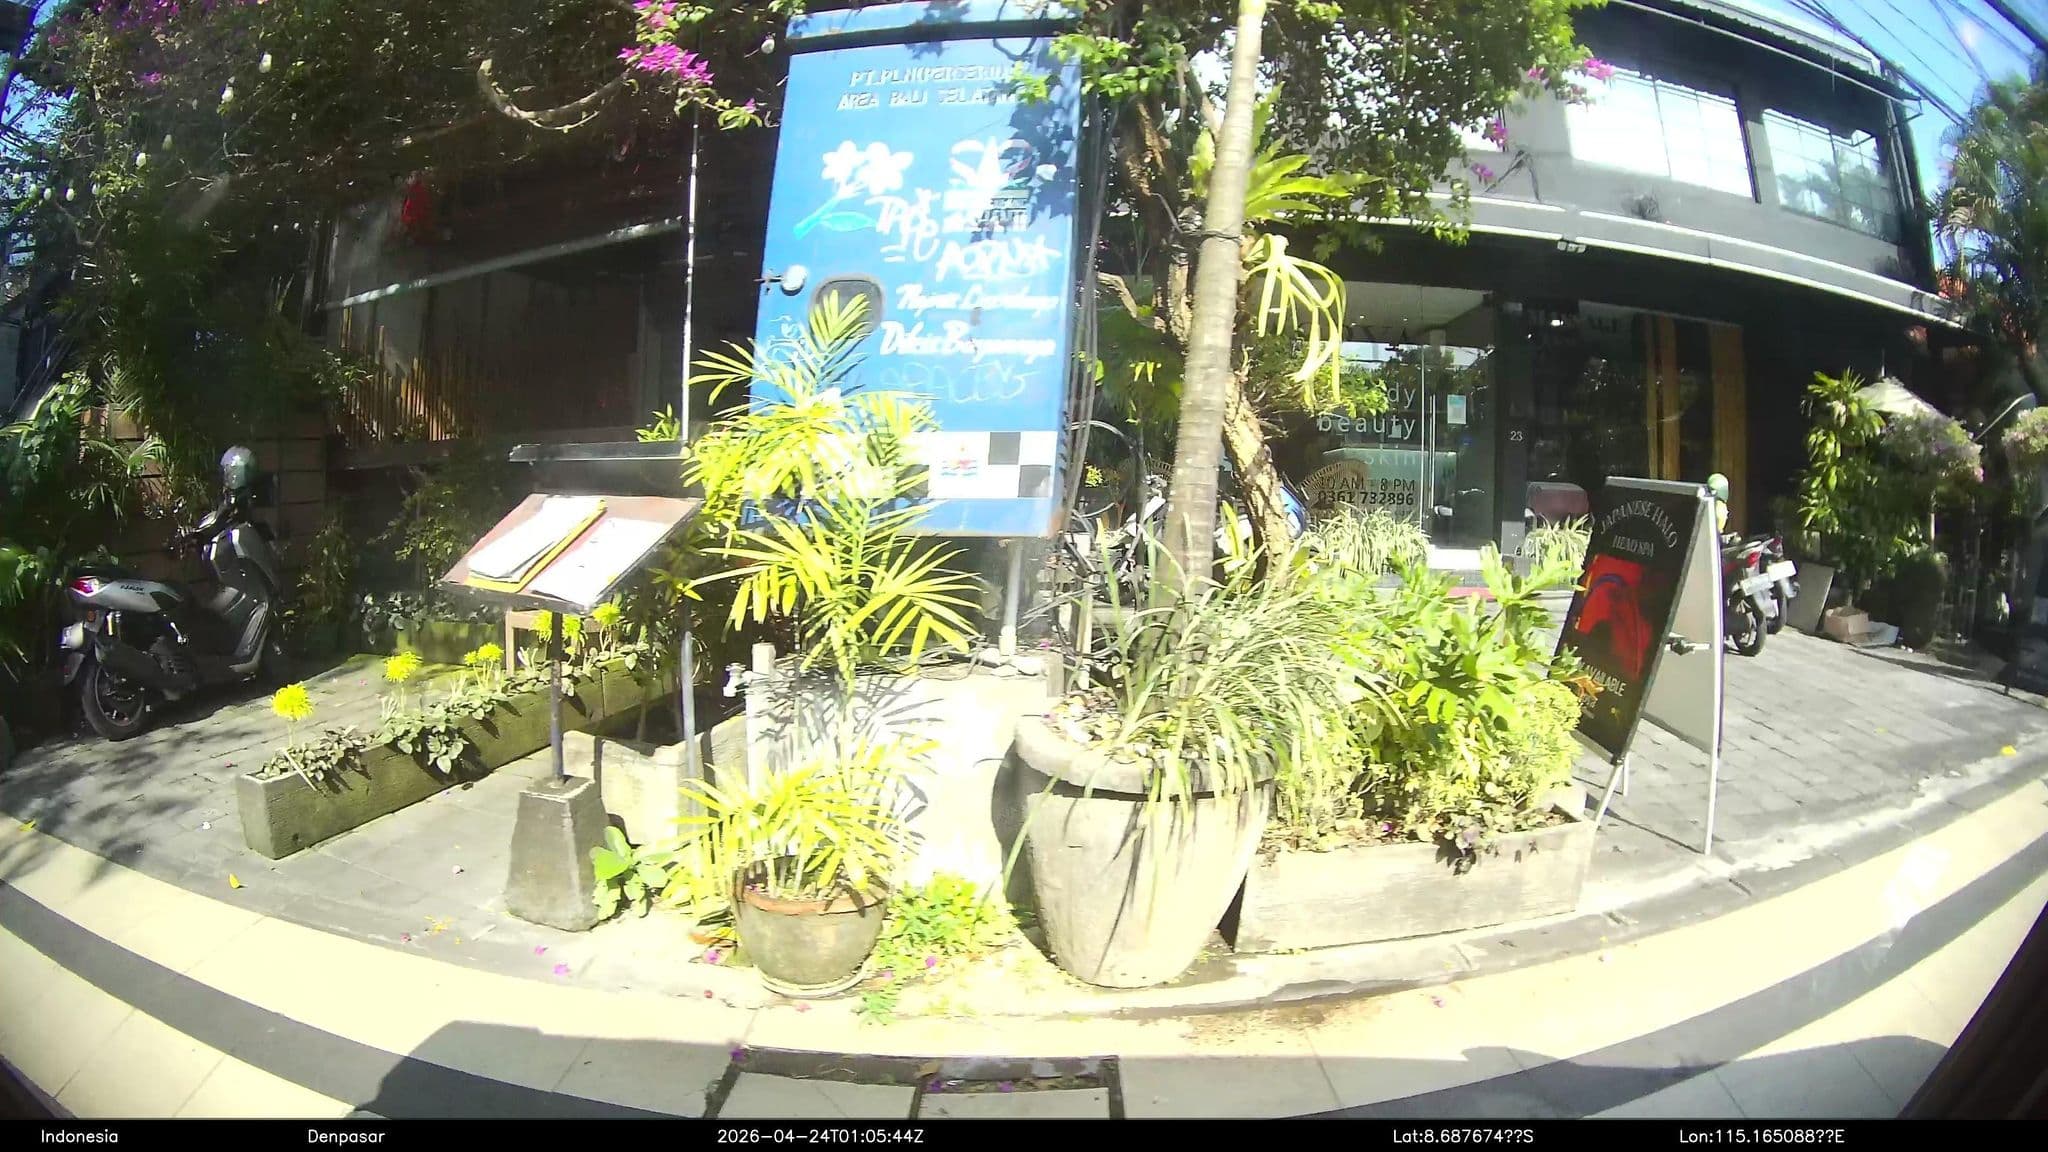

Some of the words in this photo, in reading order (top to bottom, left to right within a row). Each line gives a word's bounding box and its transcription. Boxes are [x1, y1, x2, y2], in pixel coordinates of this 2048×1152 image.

[888, 90, 929, 106] BALI
[1387, 382, 1417, 409] dy
[1317, 412, 1416, 440] beauty
[1510, 430, 1523, 442] 23
[1340, 476, 1364, 492] AM
[1379, 478, 1389, 492] 8
[1393, 478, 1415, 494] PM
[1318, 489, 1355, 503] 0361
[1359, 491, 1415, 507] 732896
